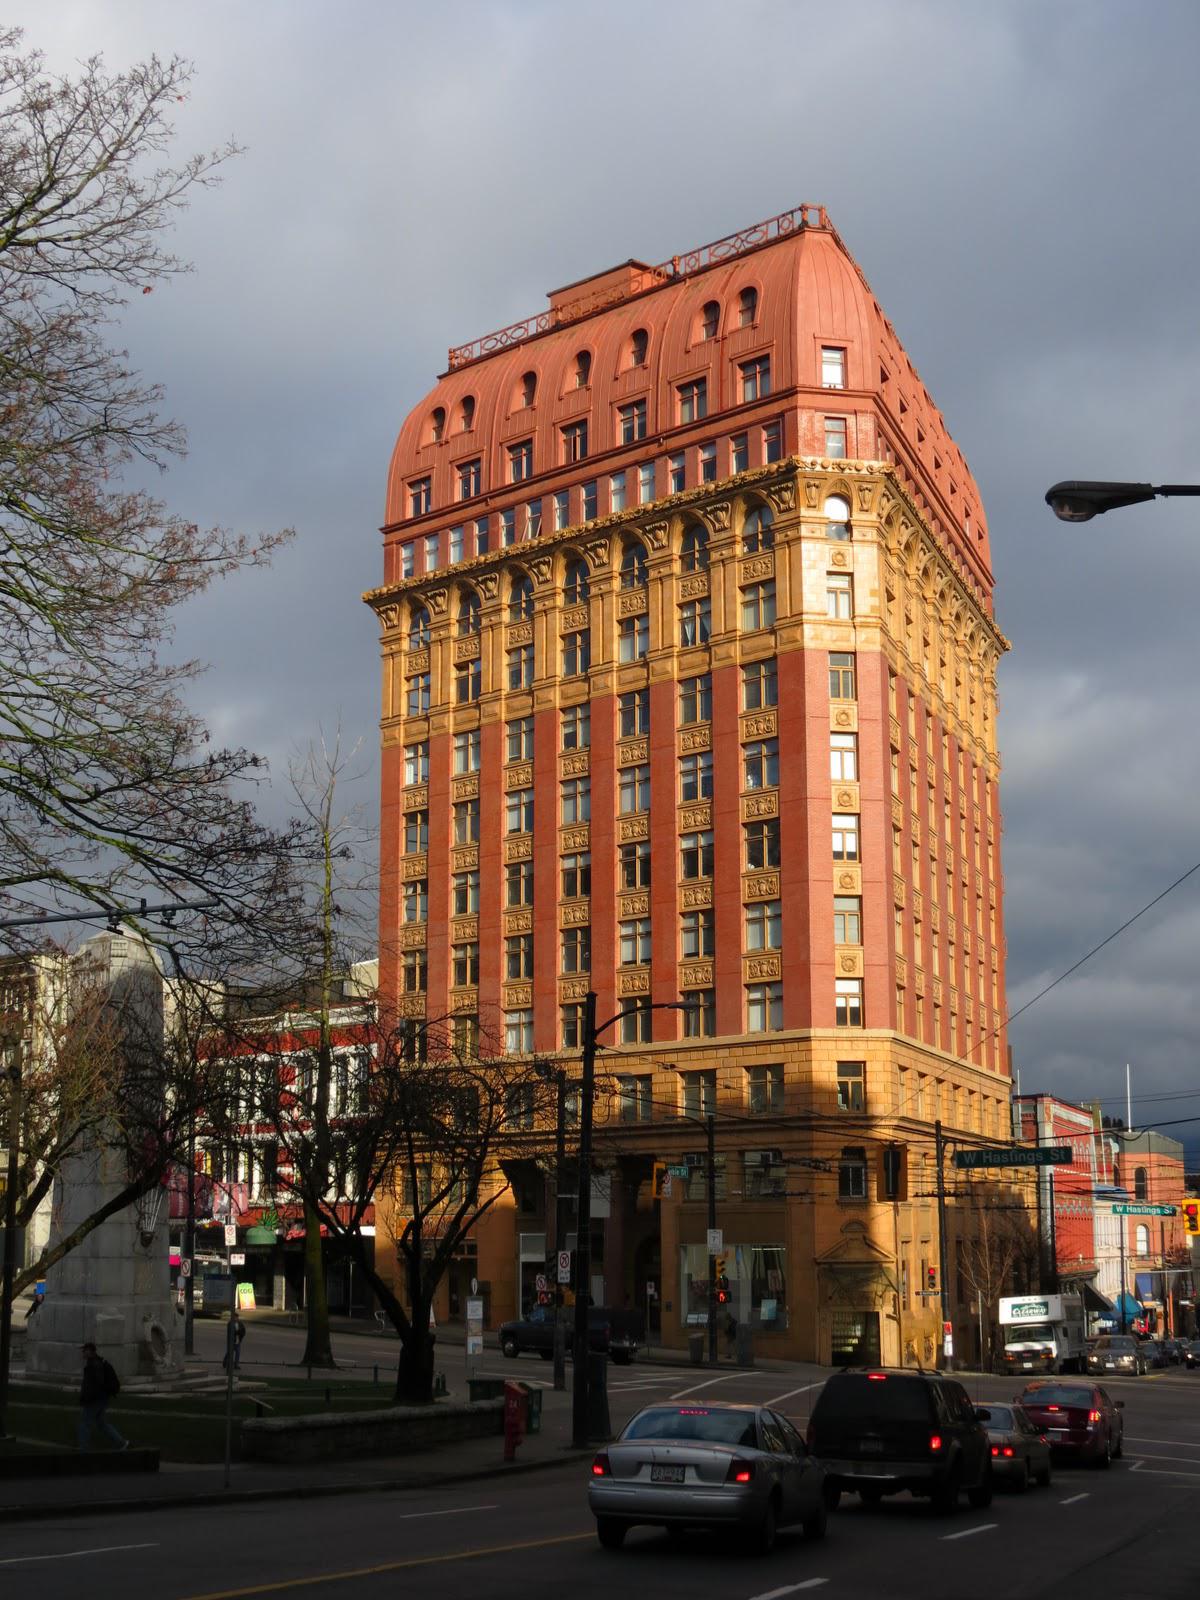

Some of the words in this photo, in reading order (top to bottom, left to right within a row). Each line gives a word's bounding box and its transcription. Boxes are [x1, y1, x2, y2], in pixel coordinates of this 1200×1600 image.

[963, 1152, 976, 1164] W
[982, 1150, 1043, 1164] Hastings
[1050, 1149, 1066, 1161] St
[1115, 1205, 1124, 1213] W
[1126, 1205, 1161, 1215] Hastings
